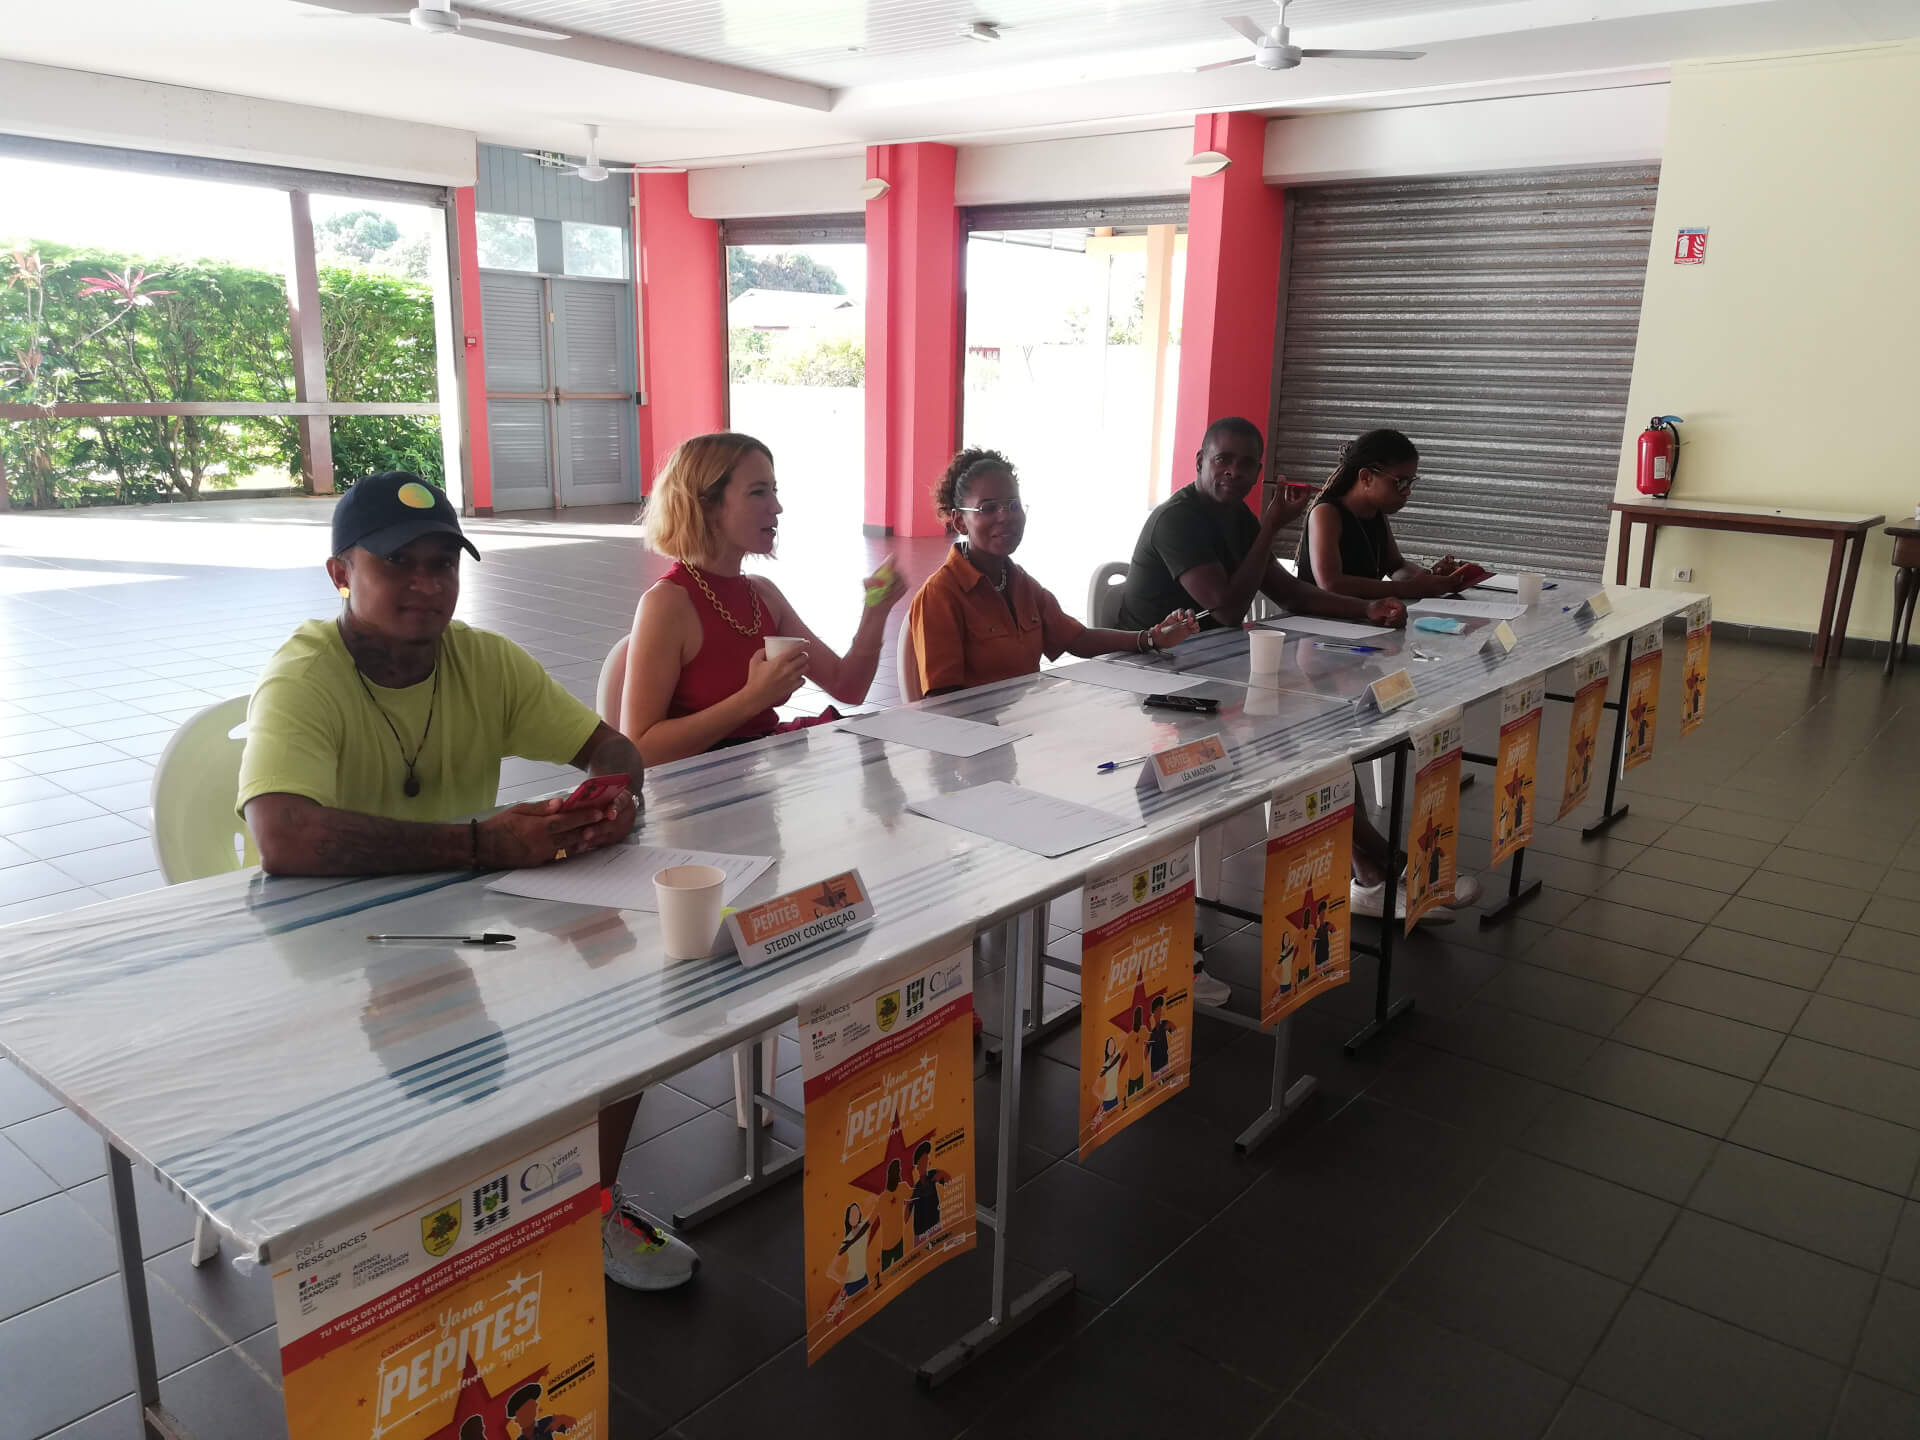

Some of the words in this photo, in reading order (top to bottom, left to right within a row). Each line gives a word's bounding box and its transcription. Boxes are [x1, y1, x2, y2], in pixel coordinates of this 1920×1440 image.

[752, 902, 800, 934] PEPITES
[764, 931, 802, 955] STEDDY
[803, 910, 857, 939] CONCEIÇAO
[1109, 937, 1170, 991] PEPITES
[848, 1069, 936, 1148] PEPITES
[297, 1231, 367, 1272] RESSOURCES
[320, 1327, 332, 1340] TU
[333, 1314, 360, 1333] VEUX
[360, 1295, 398, 1320] DEVENIR
[421, 1267, 453, 1288] ARTISTE
[530, 1217, 542, 1229] TU
[423, 1272, 454, 1295] REMIRE
[380, 1322, 436, 1358] CONCOURS
[439, 1300, 485, 1339] Yana
[380, 1290, 538, 1418] PEPITES
[548, 1352, 595, 1386] INSCRIPTION
